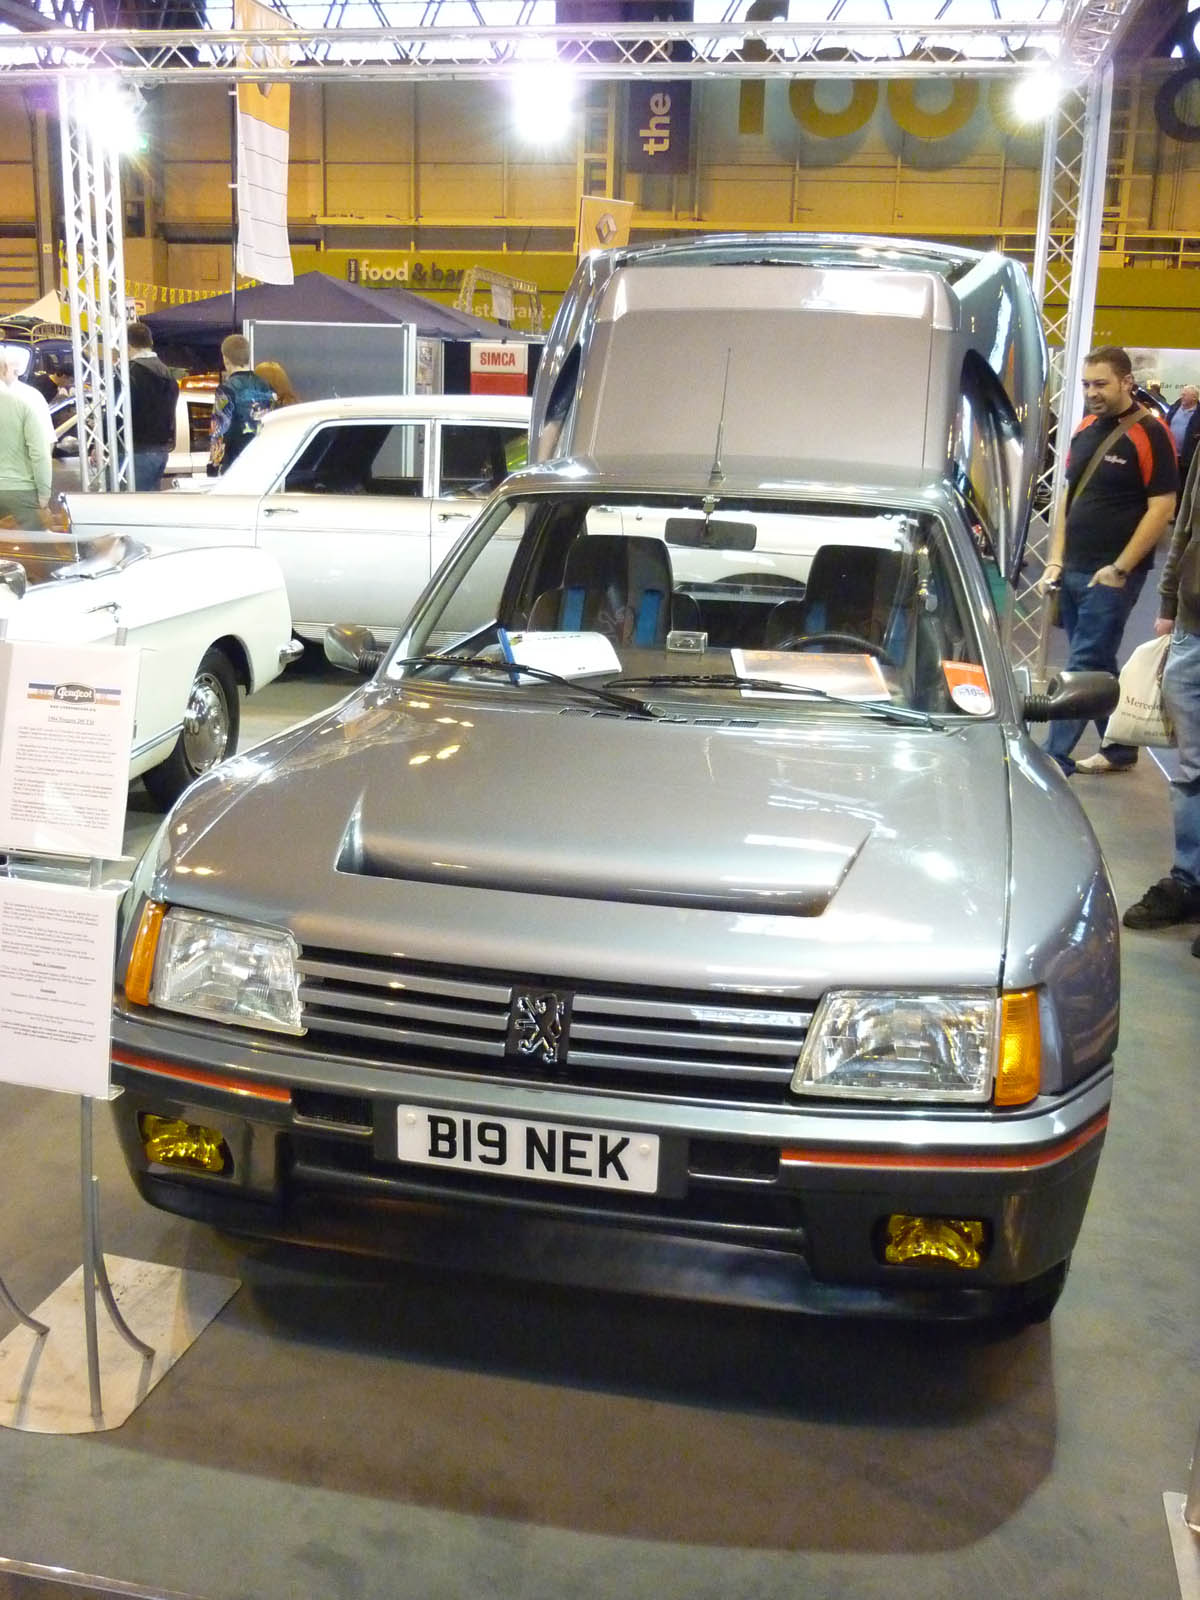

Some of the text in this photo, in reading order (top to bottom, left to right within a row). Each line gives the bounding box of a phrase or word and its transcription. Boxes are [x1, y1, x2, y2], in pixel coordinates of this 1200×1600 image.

[639, 92, 671, 156] the
[360, 259, 464, 283] food & bar
[480, 351, 516, 366] SIMCA
[526, 1126, 630, 1181] NEK
